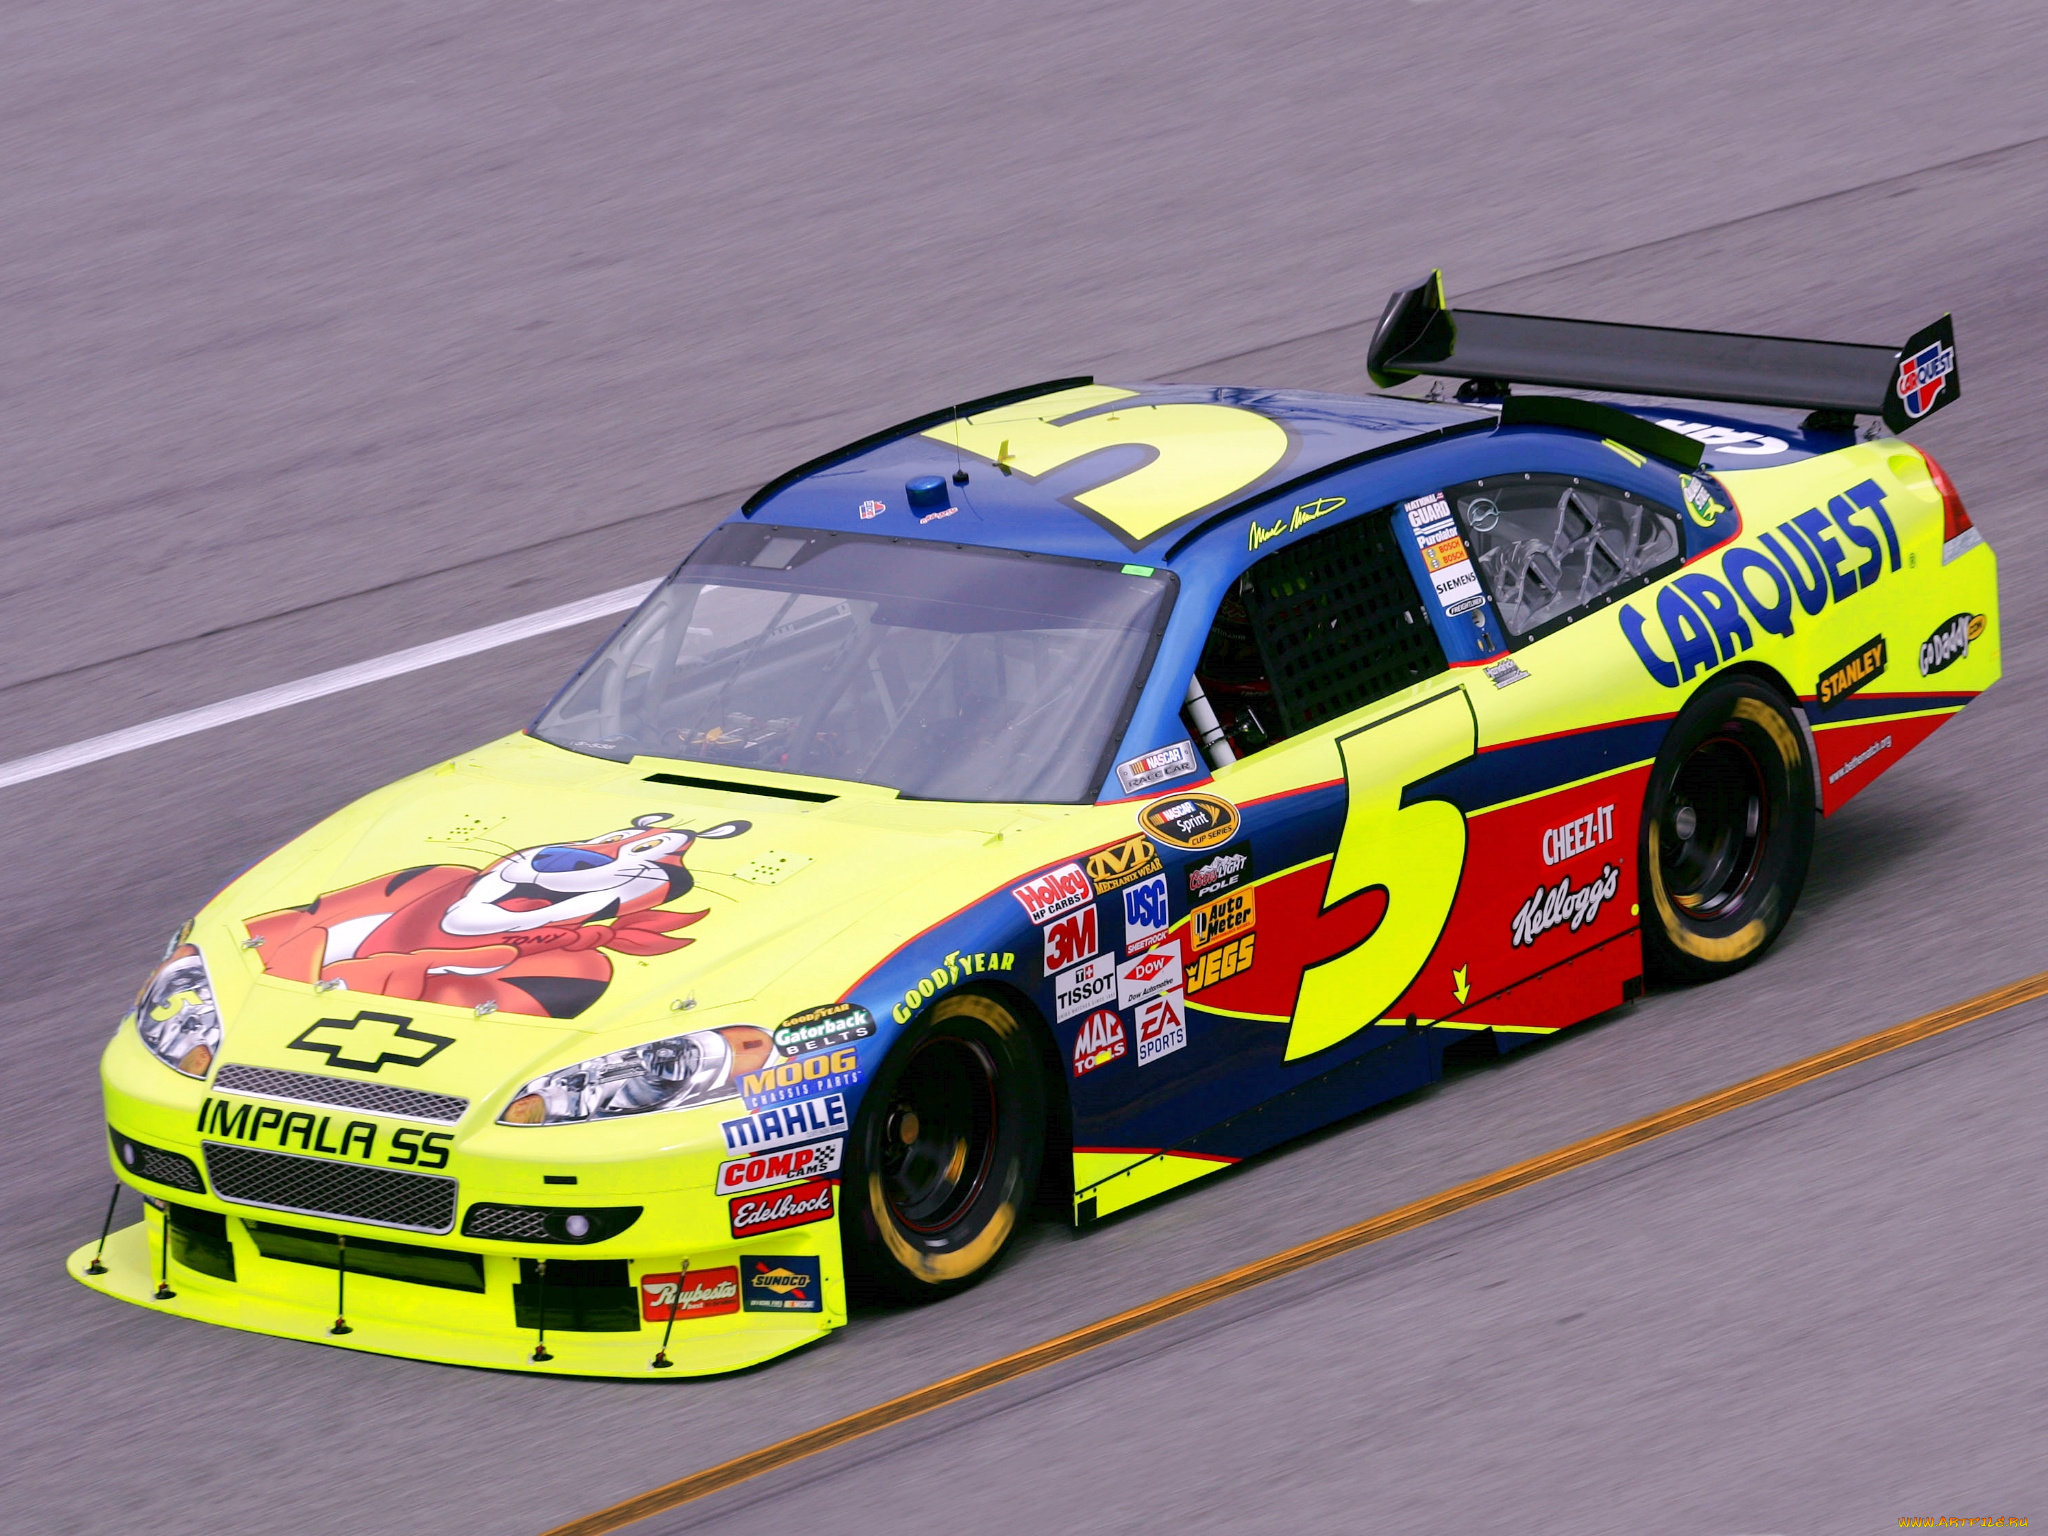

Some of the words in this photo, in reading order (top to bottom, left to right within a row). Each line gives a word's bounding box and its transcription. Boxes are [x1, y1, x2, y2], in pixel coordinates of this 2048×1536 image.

[921, 384, 1292, 545] 5
[1408, 501, 1451, 527] GUARD
[1417, 527, 1458, 548] Purolator
[1439, 541, 1460, 553] BOSCH
[1443, 550, 1465, 563] BOSCH
[1436, 572, 1477, 594] SIEMENS
[1619, 478, 1901, 687] CARQUEST
[1820, 643, 1883, 703] STANLEY
[1145, 748, 1182, 769] NASCAR
[1128, 770, 1164, 787] RACE
[1164, 763, 1190, 776] CAR
[1162, 801, 1195, 821] NASCAR
[1177, 811, 1209, 833] Sprint
[1191, 835, 1206, 846] CUP
[1207, 825, 1232, 840] SERIES
[1543, 804, 1615, 867] CHEEZ-IT
[1093, 874, 1138, 895] MECHANIX
[1138, 858, 1163, 878] WEAR
[1218, 856, 1247, 878] LIGHT
[1282, 685, 1477, 1065] 5
[1015, 870, 1090, 912] Holley
[1198, 875, 1239, 897] POLE
[1032, 908, 1046, 921] HP
[1048, 893, 1081, 914] CARBS
[1126, 879, 1166, 929] USG
[1210, 896, 1243, 922] Auto
[1513, 865, 1618, 946] Kellogg's
[501, 932, 567, 945] TONY
[1046, 907, 1096, 970] 3M
[1208, 908, 1251, 938] Meter
[1128, 931, 1165, 954] SHEETROCK
[1135, 958, 1165, 979] DOW
[1187, 934, 1255, 994] JEGS
[892, 950, 1015, 1025] GOODYEAR
[1057, 973, 1114, 1010] TISSOT
[1128, 992, 1141, 1002] Dow
[1142, 978, 1174, 996] Automotive
[775, 1010, 868, 1046] Gatorback
[782, 1003, 850, 1028] GOODYEAR
[1140, 1000, 1181, 1042] EA
[786, 1027, 868, 1055] BELTS
[1075, 1010, 1124, 1060] MAC
[1140, 1028, 1184, 1061] SPORTS
[743, 1047, 857, 1097] MOOG
[751, 1084, 809, 1107] CHASSIS
[818, 1072, 858, 1091] PARTS
[197, 1098, 377, 1159] IMPALA
[388, 1128, 454, 1169] SS
[722, 1094, 845, 1148] MAHLE
[724, 1149, 814, 1186] COMP
[786, 1162, 828, 1179] CAMS
[734, 1188, 830, 1227] Edelbrock
[755, 1276, 807, 1287] SUNOCO
